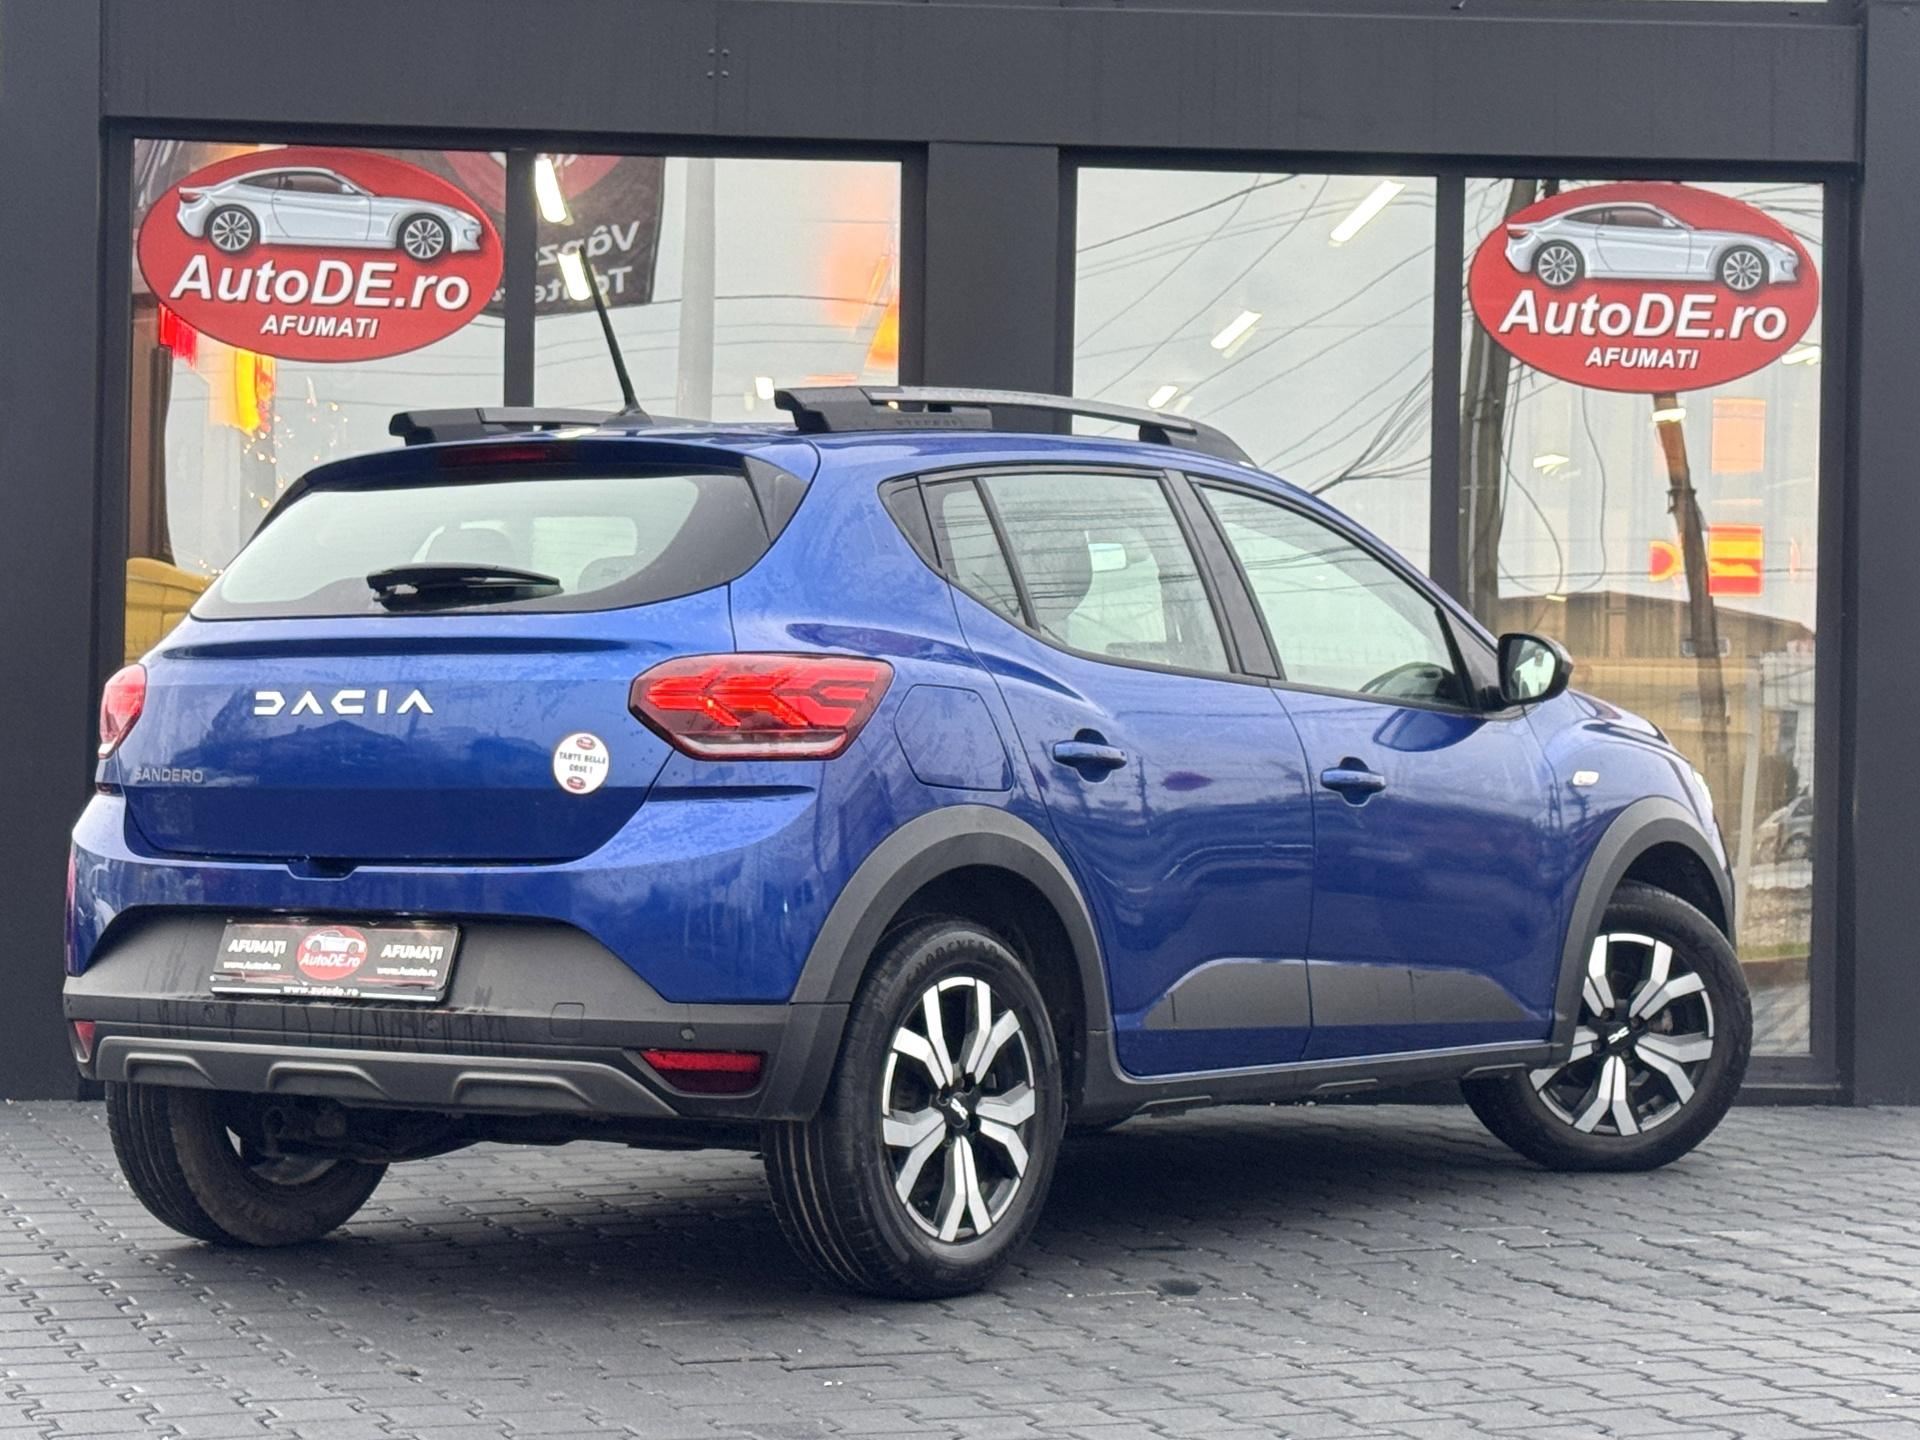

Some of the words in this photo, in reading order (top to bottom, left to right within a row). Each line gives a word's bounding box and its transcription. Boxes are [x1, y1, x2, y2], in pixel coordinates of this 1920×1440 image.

[170, 254, 470, 310] AutoDE.ro
[260, 315, 379, 339] AFUMATI
[1498, 289, 1788, 341] AutoDE.ro
[1584, 346, 1699, 370] AFUMATI
[253, 689, 434, 716] DACIA
[134, 767, 204, 784] SANDERO
[298, 952, 361, 968] AutoDE.ro
